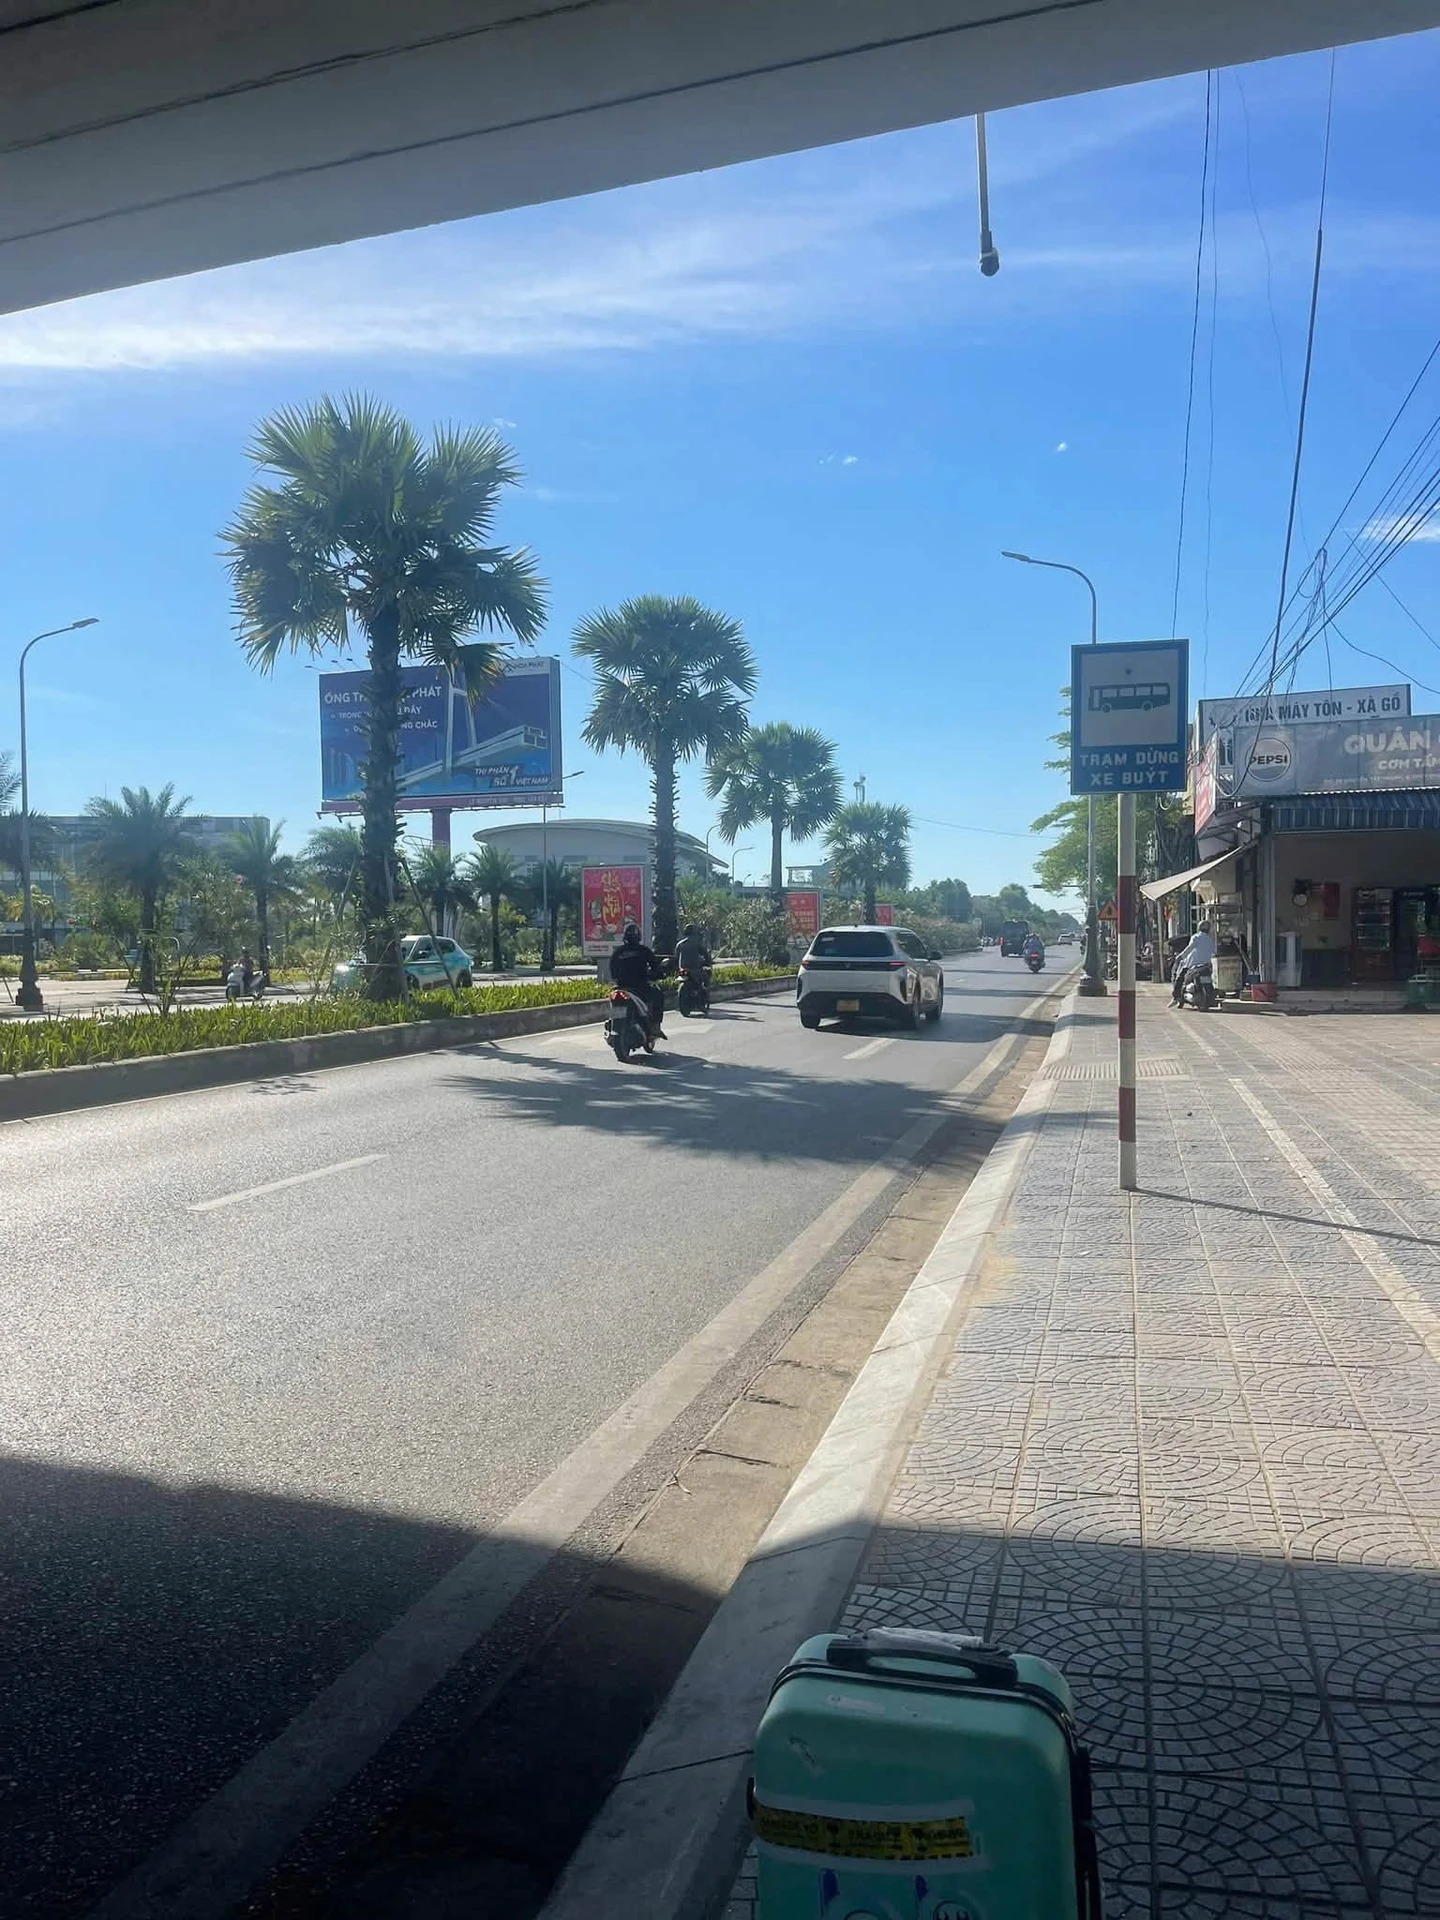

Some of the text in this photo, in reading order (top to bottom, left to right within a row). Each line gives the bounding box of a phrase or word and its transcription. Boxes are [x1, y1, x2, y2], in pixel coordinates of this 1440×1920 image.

[1314, 700, 1342, 717] TÔN
[1343, 726, 1431, 755] QUÁN
[1080, 753, 1127, 769] TRẠM
[1249, 754, 1288, 765] PEPSI
[1378, 758, 1410, 770] CƠM
[1090, 772, 1114, 786] XE
